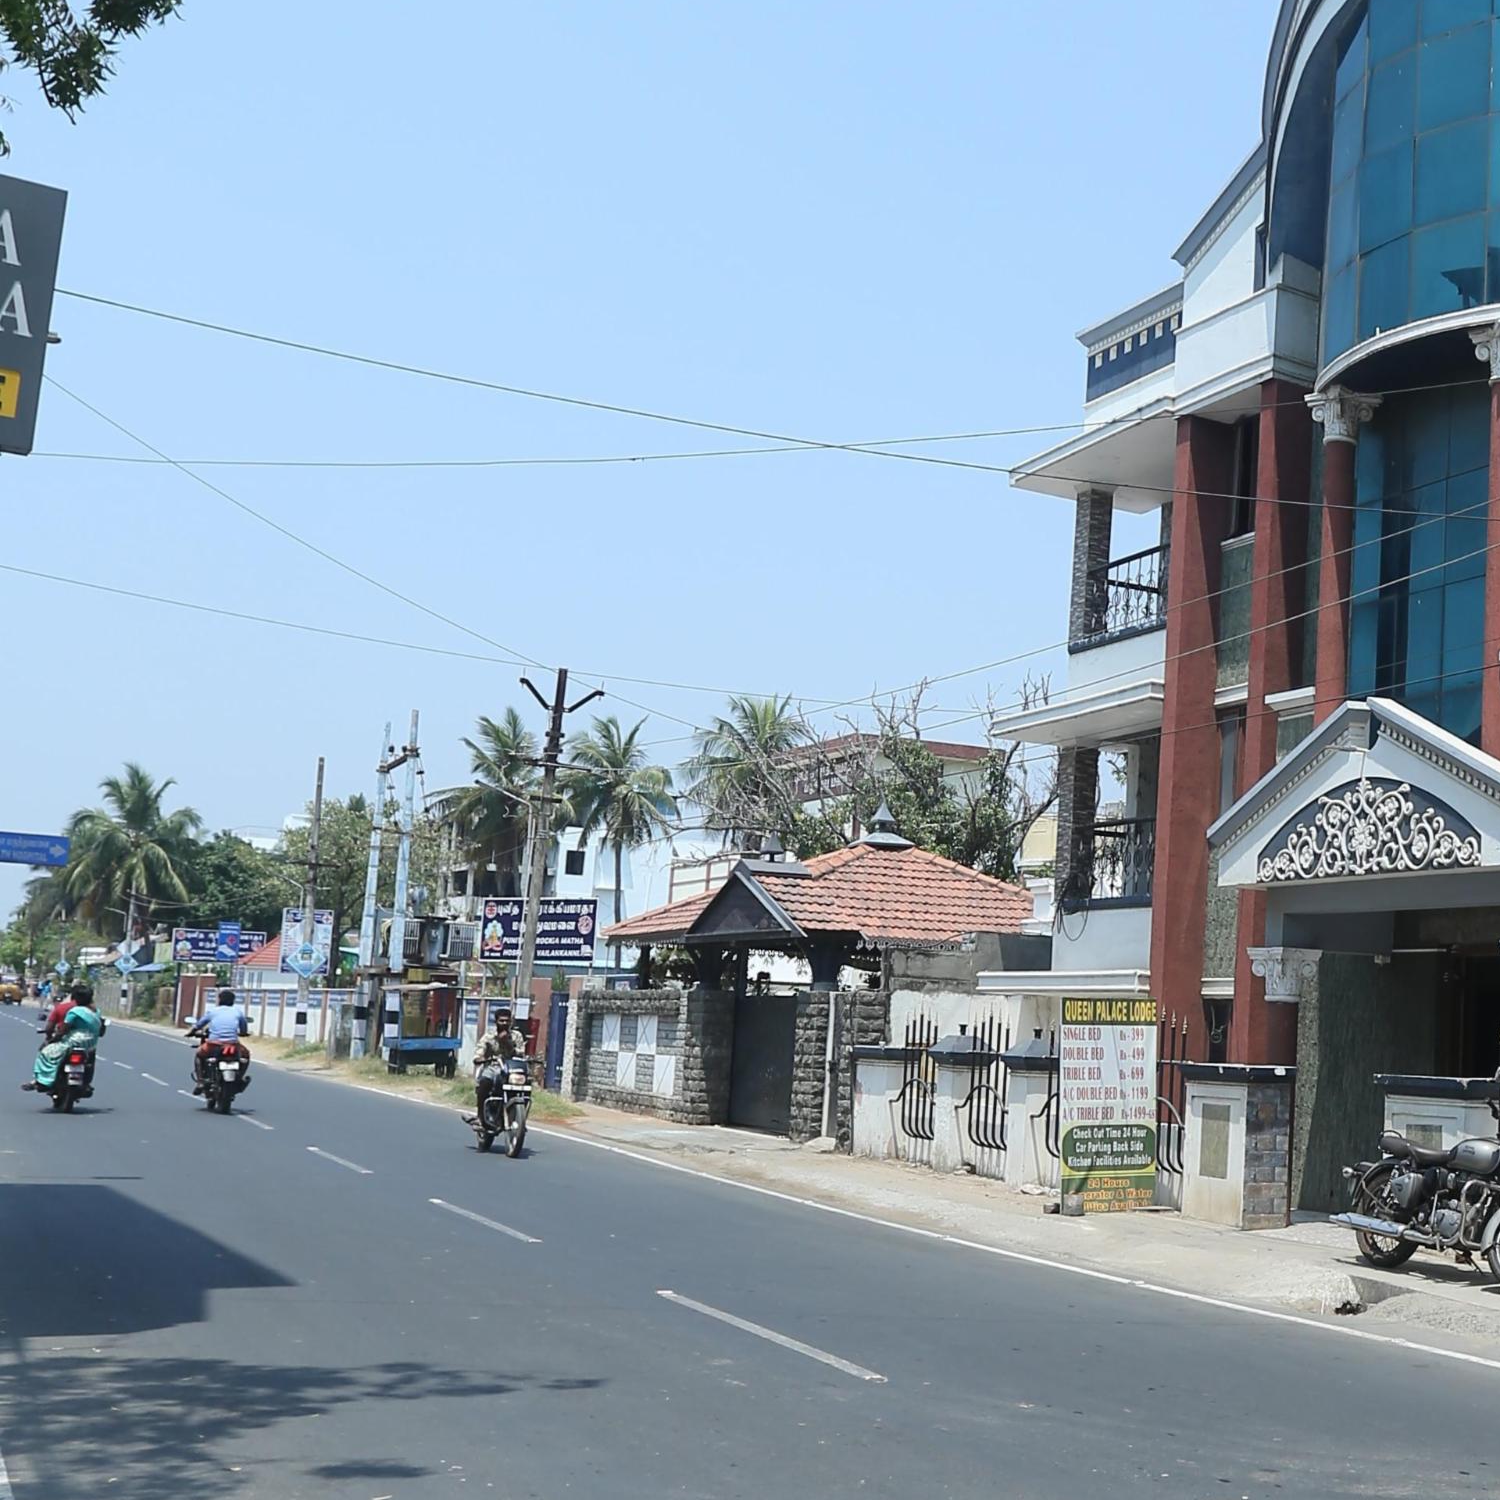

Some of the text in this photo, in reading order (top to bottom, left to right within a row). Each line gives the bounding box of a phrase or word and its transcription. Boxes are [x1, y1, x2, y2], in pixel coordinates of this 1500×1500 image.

[1064, 1000, 1157, 1022] QUEEN PALACE LODGE
[1063, 1027, 1086, 1041] SINGLE
[1088, 1027, 1101, 1041] BED
[1063, 1046, 1089, 1060] DOUBLE
[1091, 1046, 1104, 1060] BED
[1063, 1067, 1086, 1080] TRIBLE
[1088, 1067, 1101, 1080] BED
[1077, 1086, 1102, 1100] DOUBLE
[1104, 1086, 1118, 1100] BED
[1077, 1106, 1099, 1121] TRIBLE
[1101, 1106, 1115, 1121] BED
[1073, 1126, 1147, 1139] Check Out Time 24 Hour
[1075, 1140, 1144, 1154] Car Parking Back Side
[1068, 1154, 1152, 1167] Kitchen Facilities Available
[1088, 1178, 1130, 1188] 24 Hours
[1126, 1188, 1152, 1198] Water
